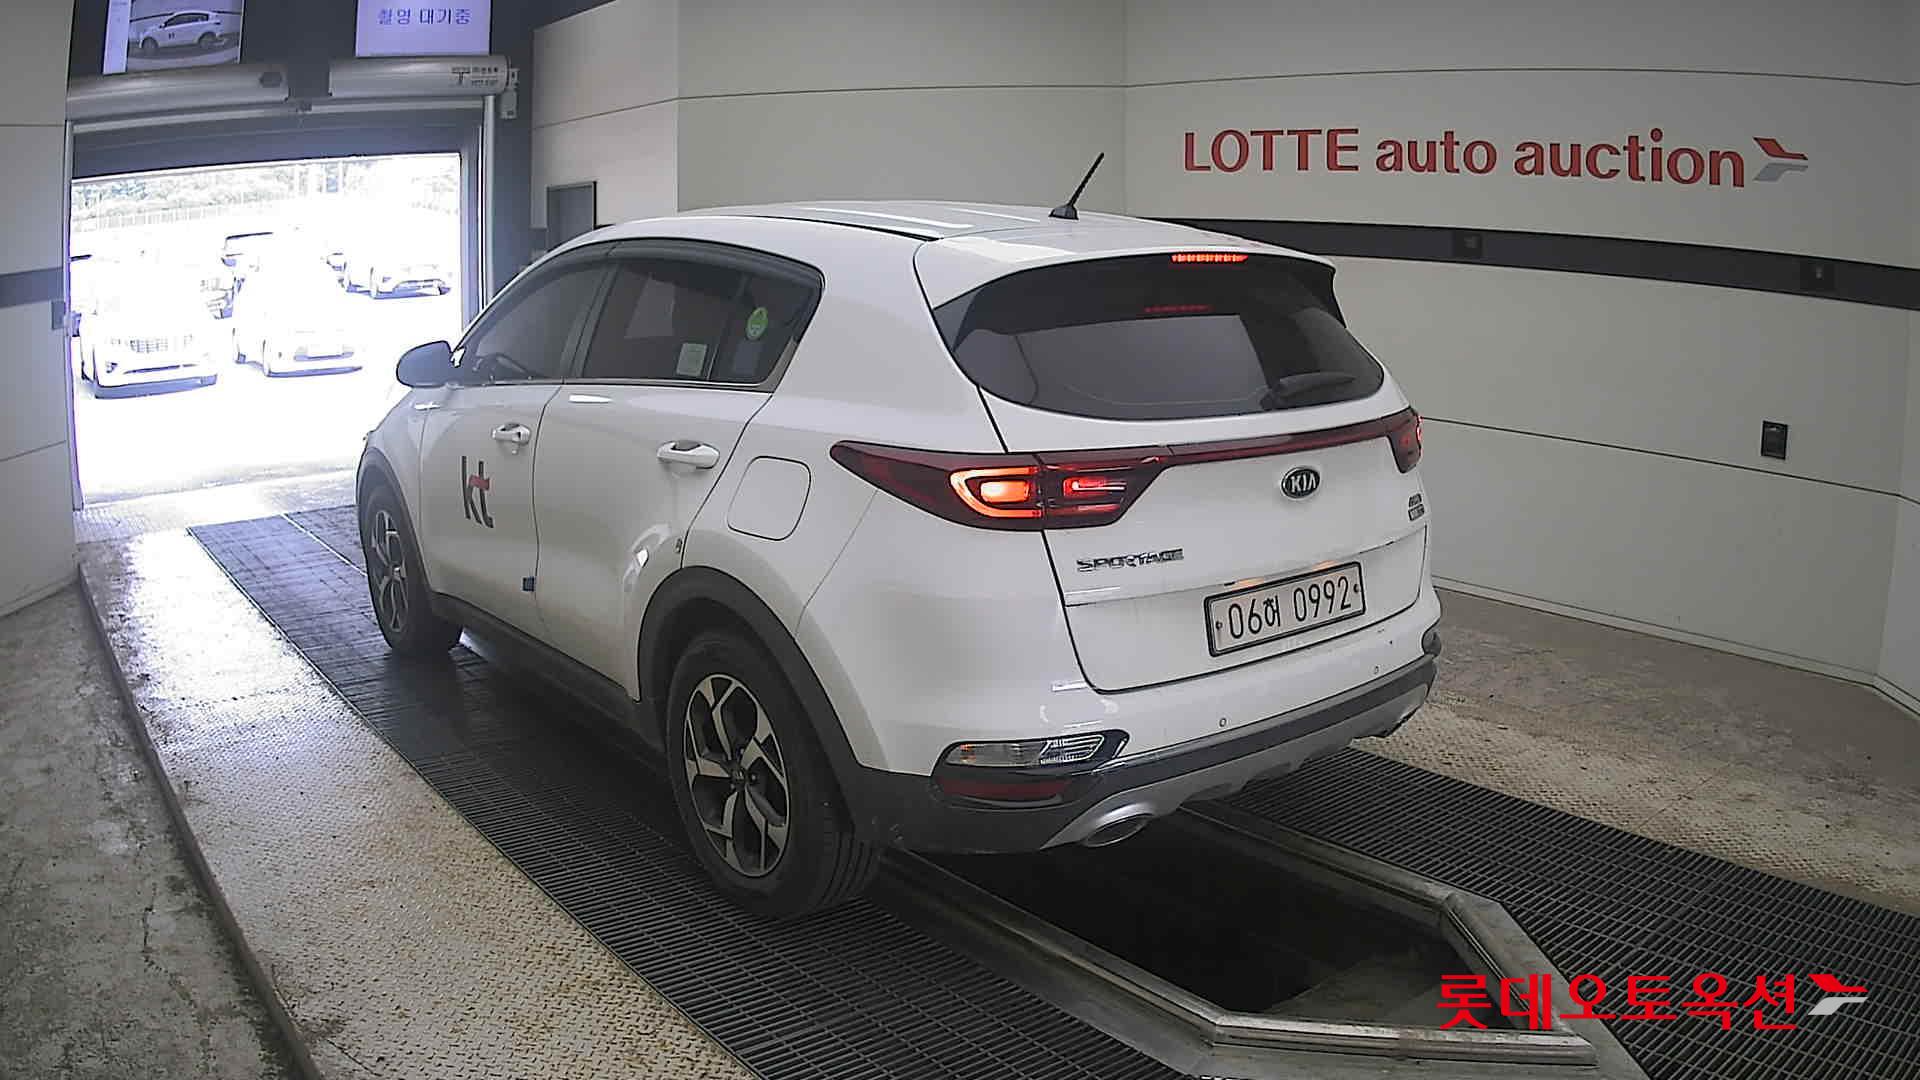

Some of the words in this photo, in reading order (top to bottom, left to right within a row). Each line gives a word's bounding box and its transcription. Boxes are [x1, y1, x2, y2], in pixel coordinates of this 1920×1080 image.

[419, 8, 471, 25] 대기중
[1185, 128, 1359, 172] LOTTE
[1376, 131, 1497, 174] auto
[1514, 128, 1745, 188] auction
[462, 456, 494, 528] kt
[1289, 472, 1317, 493] KIA
[1077, 548, 1184, 572] SPORTAGE
[1228, 596, 1281, 639] 06허
[1293, 576, 1351, 622] 0992
